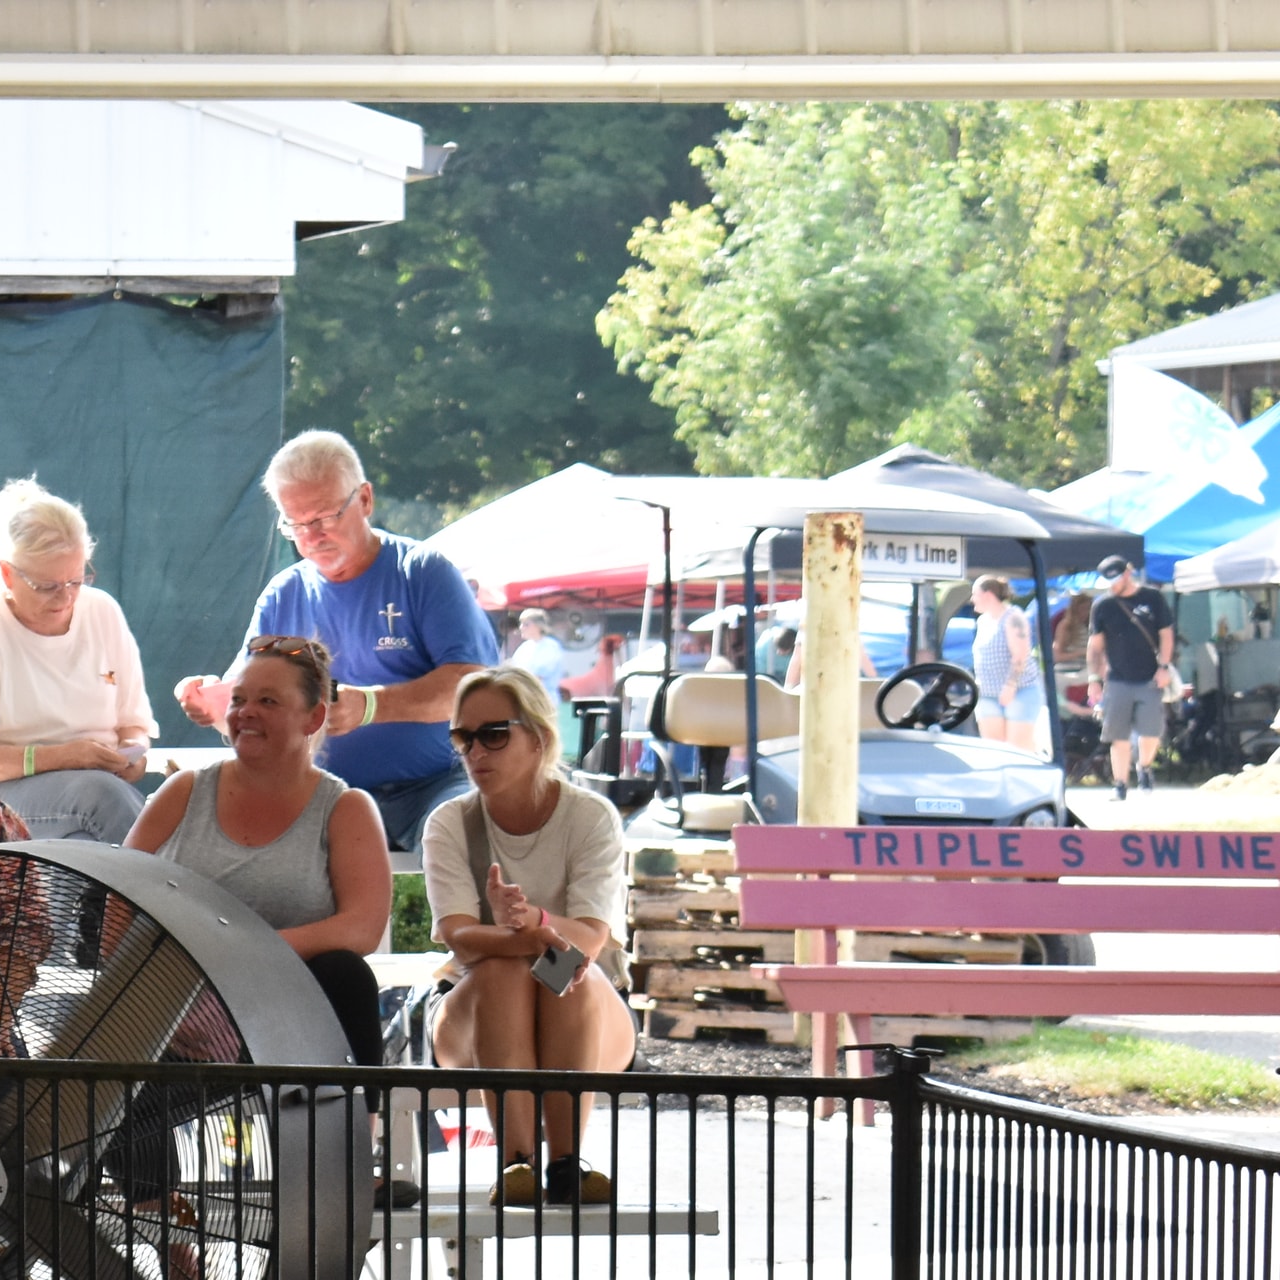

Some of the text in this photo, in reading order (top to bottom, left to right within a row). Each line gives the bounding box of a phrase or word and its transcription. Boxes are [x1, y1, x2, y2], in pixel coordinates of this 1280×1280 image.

[862, 541, 958, 564] rk Ag Lime
[844, 831, 1277, 870] TRIPLE S SWINE
